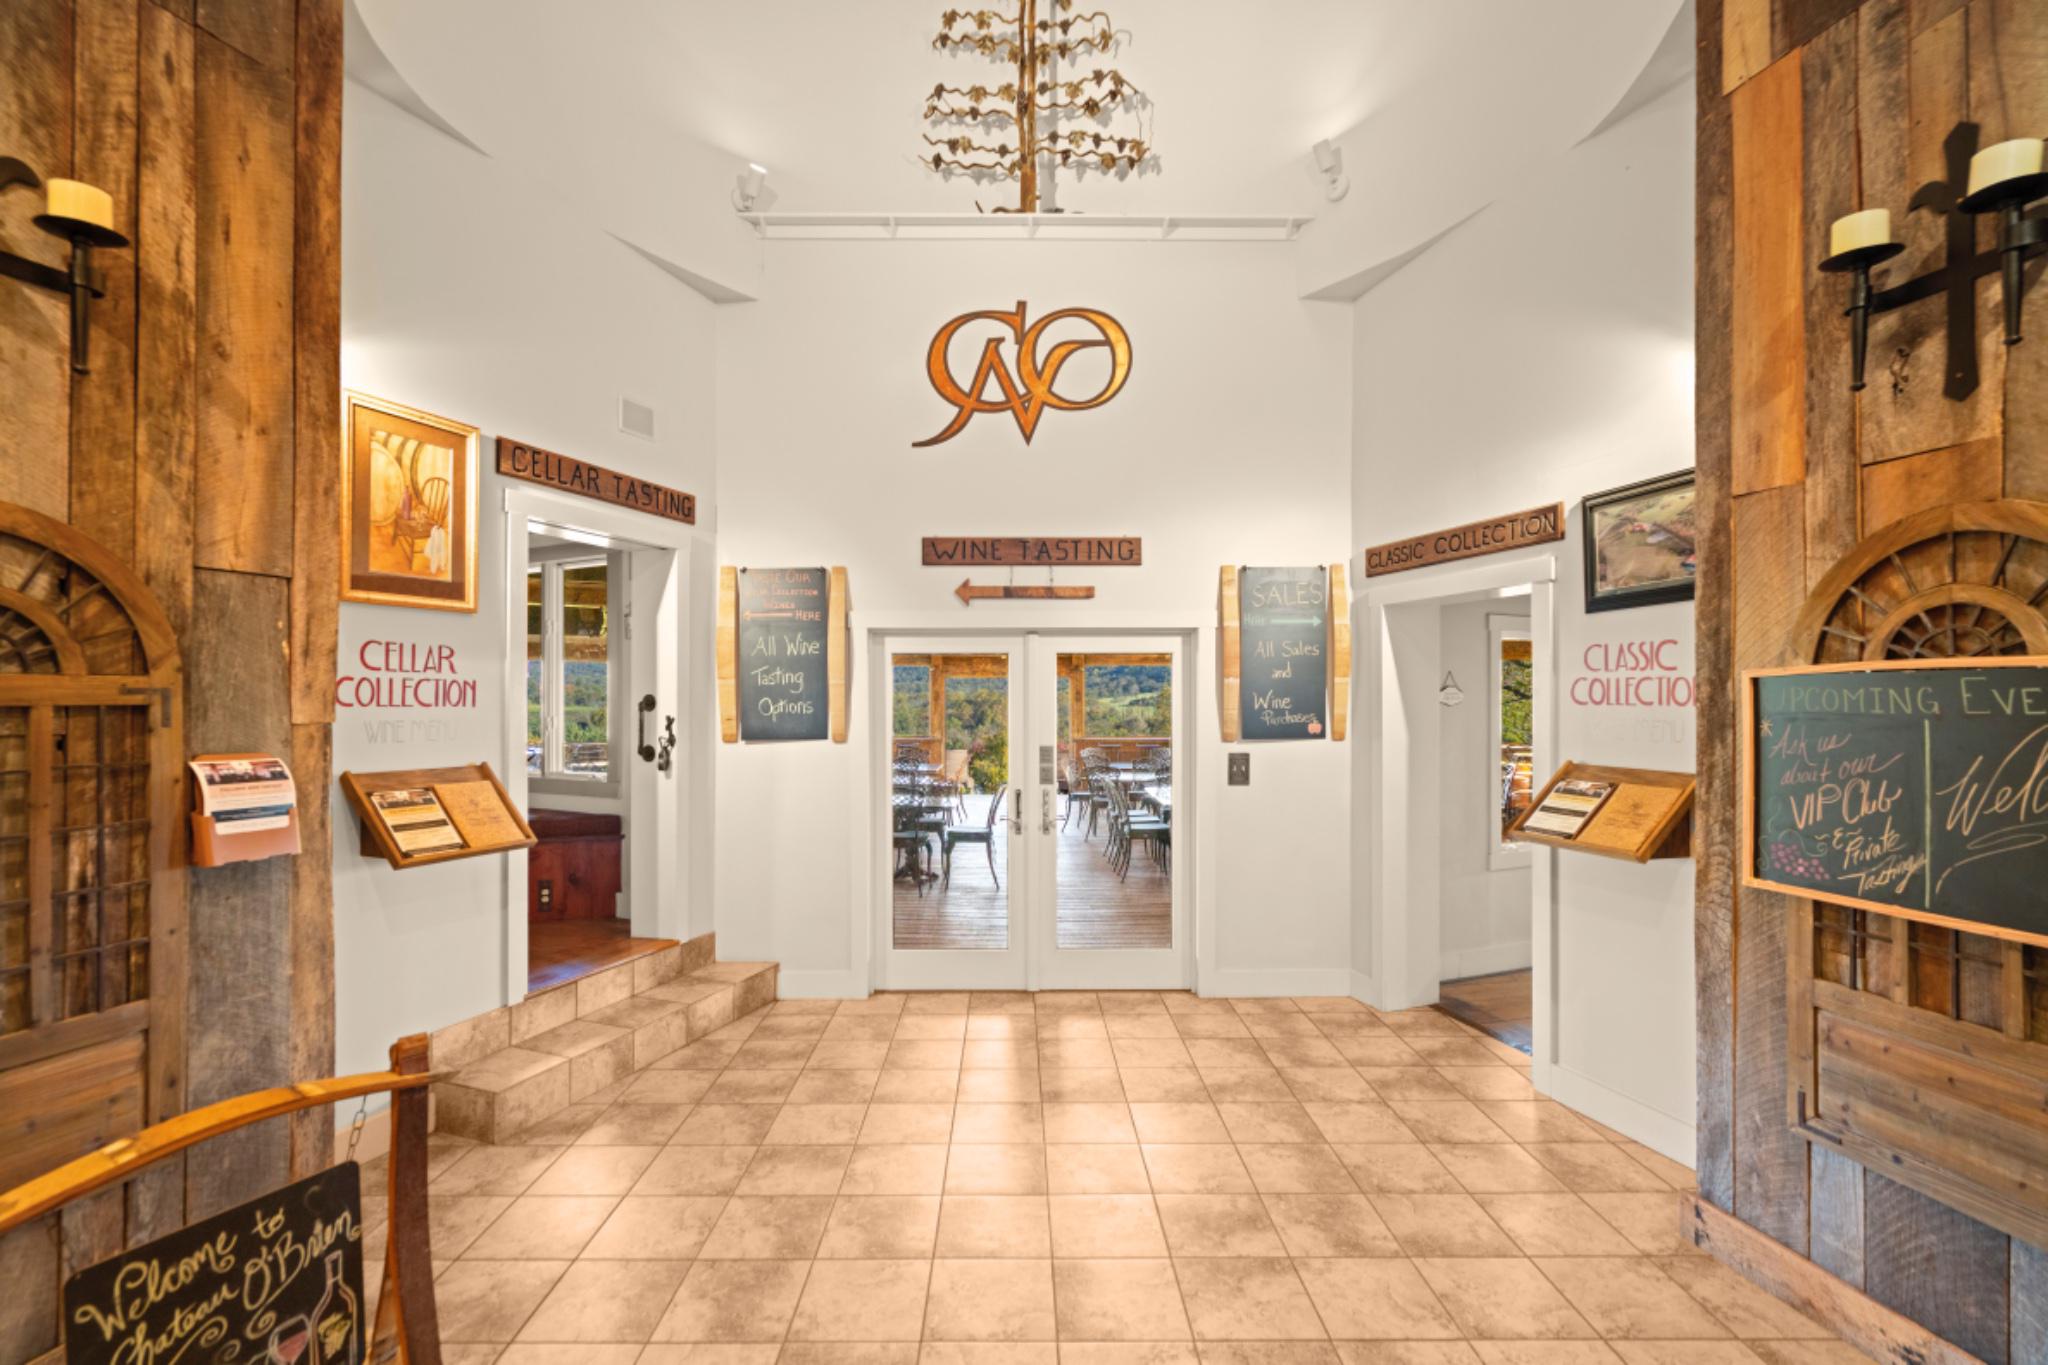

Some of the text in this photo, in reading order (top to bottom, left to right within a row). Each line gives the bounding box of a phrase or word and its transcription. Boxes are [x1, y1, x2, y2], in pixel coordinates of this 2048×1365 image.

[511, 446, 692, 518] CELLAR TASTING
[931, 540, 1135, 561] WINE TASTING
[1367, 512, 1556, 570] CLASSIC COLLECTION
[1252, 582, 1323, 608] SALES
[359, 639, 457, 674] CELLAR
[752, 633, 820, 656] All Wine
[1255, 640, 1320, 659] All Sales
[1584, 639, 1678, 672] CLASSIC
[751, 665, 804, 694] Tasting
[1271, 661, 1292, 679] and
[335, 676, 477, 708] COLLECTION
[1252, 689, 1292, 711] Wine
[1570, 676, 1696, 707] COLLECTIO
[758, 697, 814, 722] Options
[1768, 723, 1817, 767] Ask
[1780, 752, 1904, 785] about our
[1789, 777, 1902, 830] VIP Club
[1842, 815, 1908, 870] Private
[74, 1207, 285, 1342] Welcome to
